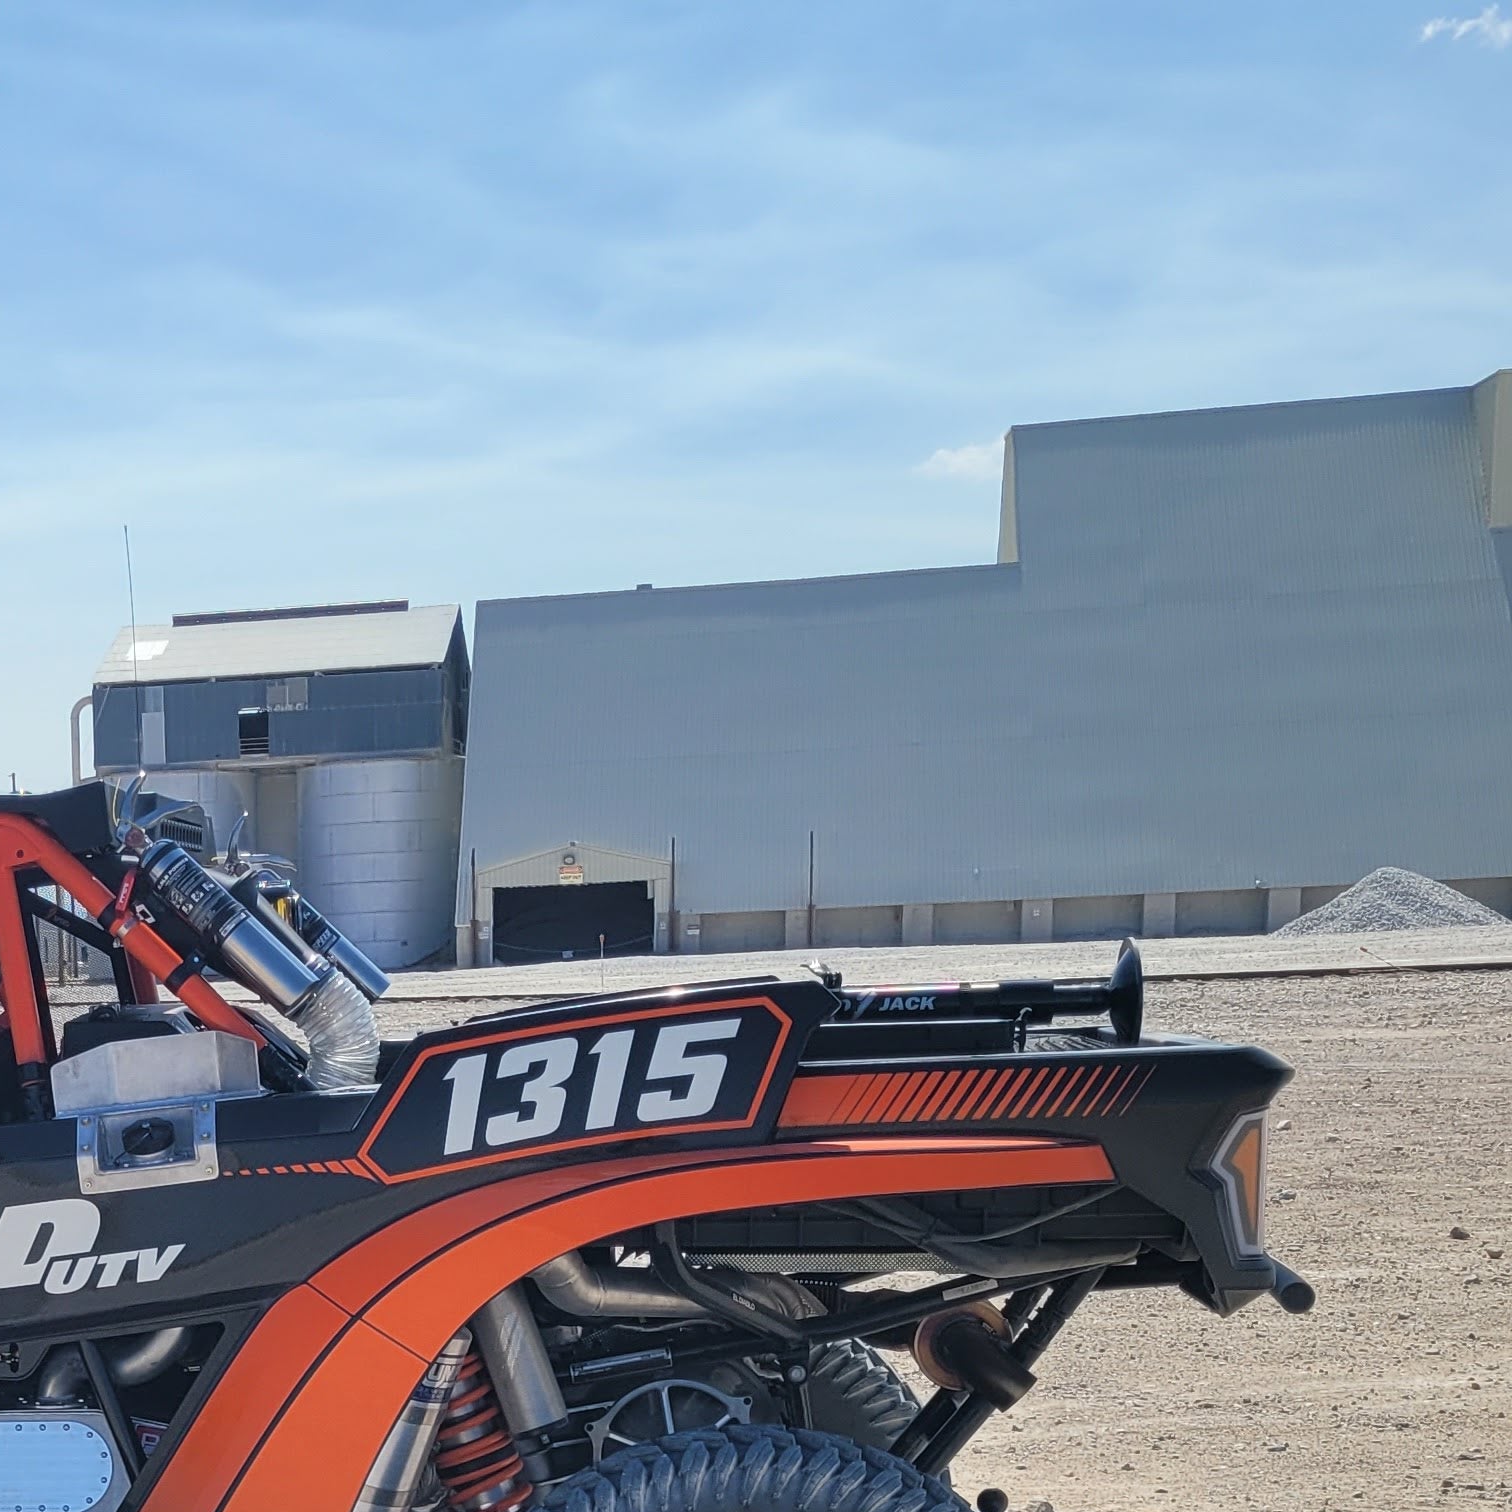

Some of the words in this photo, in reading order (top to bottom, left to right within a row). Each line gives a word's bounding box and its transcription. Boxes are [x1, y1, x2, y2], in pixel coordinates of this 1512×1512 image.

[878, 996, 936, 1012] JACK
[442, 1018, 743, 1156] 1315
[43, 1243, 187, 1295] UTV
